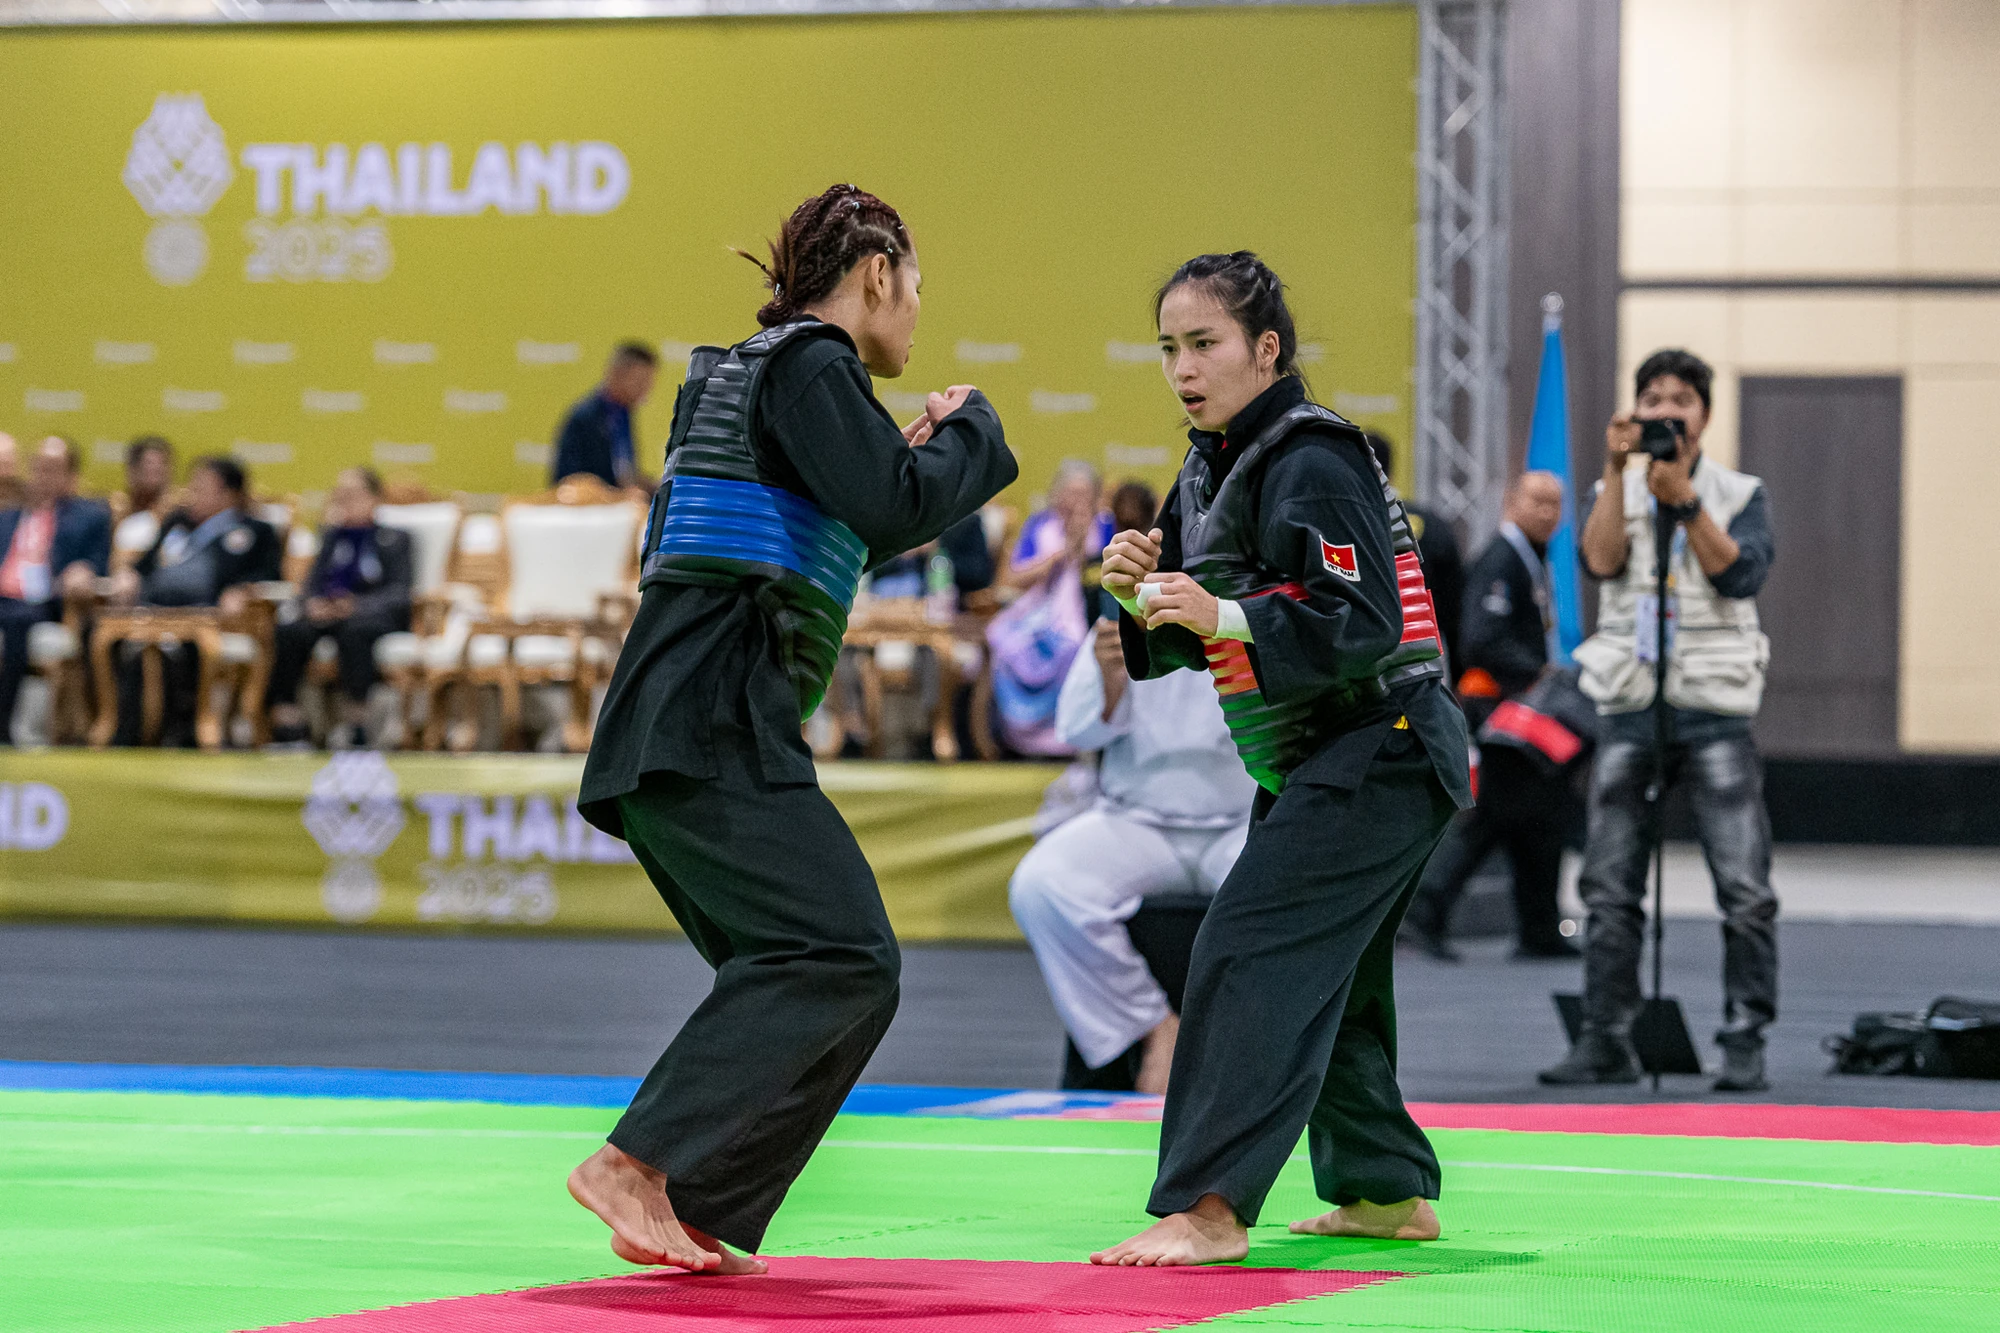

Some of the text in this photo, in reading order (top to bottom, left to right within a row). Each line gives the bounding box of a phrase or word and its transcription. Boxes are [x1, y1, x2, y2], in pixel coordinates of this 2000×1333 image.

[242, 142, 630, 216] THAILAND
[243, 218, 393, 283] 2025
[1326, 562, 1338, 571] VIET
[417, 864, 558, 924] 2025
